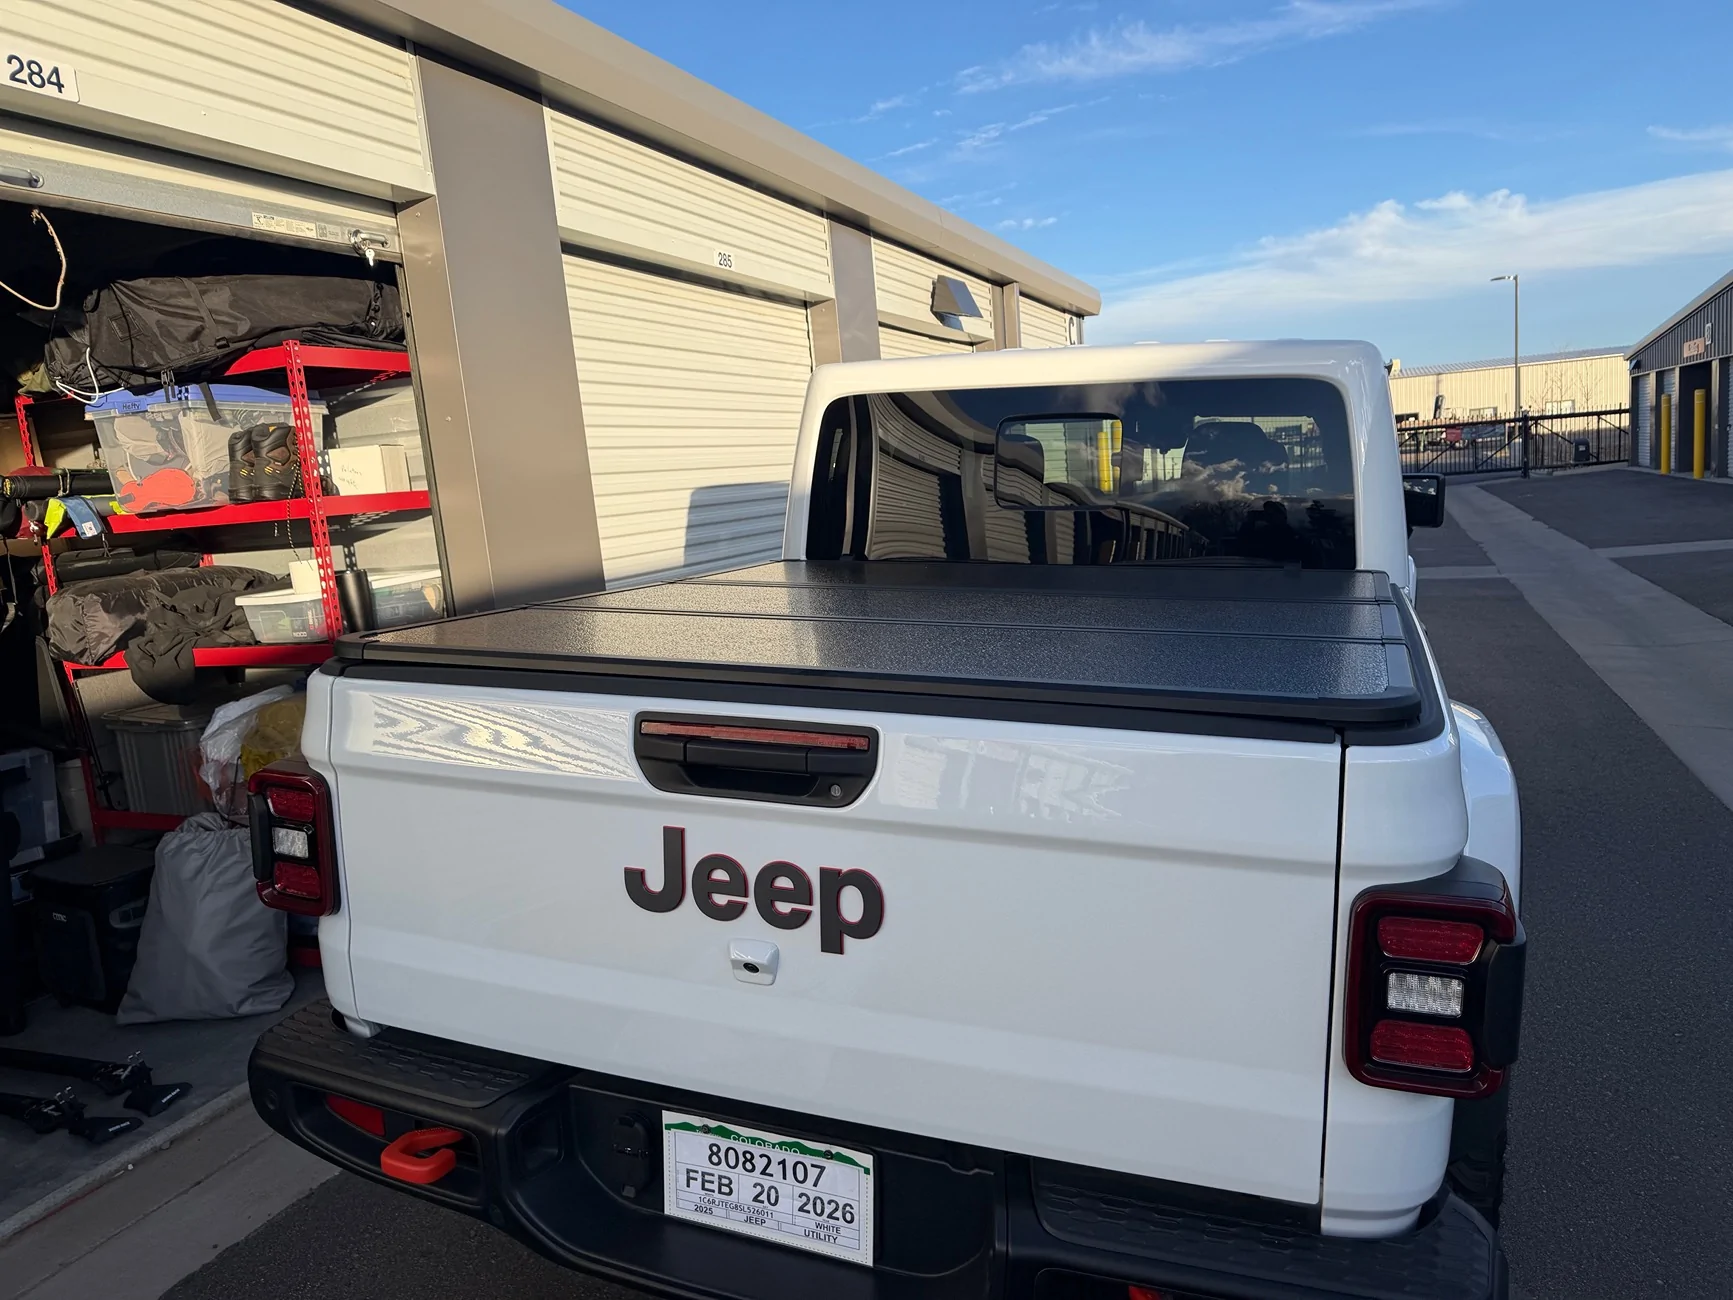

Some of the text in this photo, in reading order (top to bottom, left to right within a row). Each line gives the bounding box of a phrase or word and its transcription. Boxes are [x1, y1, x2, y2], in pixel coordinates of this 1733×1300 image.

[6, 54, 65, 94] 284
[718, 251, 733, 269] 285
[624, 825, 884, 955] Jeep
[707, 1142, 827, 1188] 8082107
[685, 1168, 855, 1225] FEB 20 2026
[693, 1203, 838, 1244] 2025 JEEP UTILITY
[814, 1221, 842, 1235] WHITE
